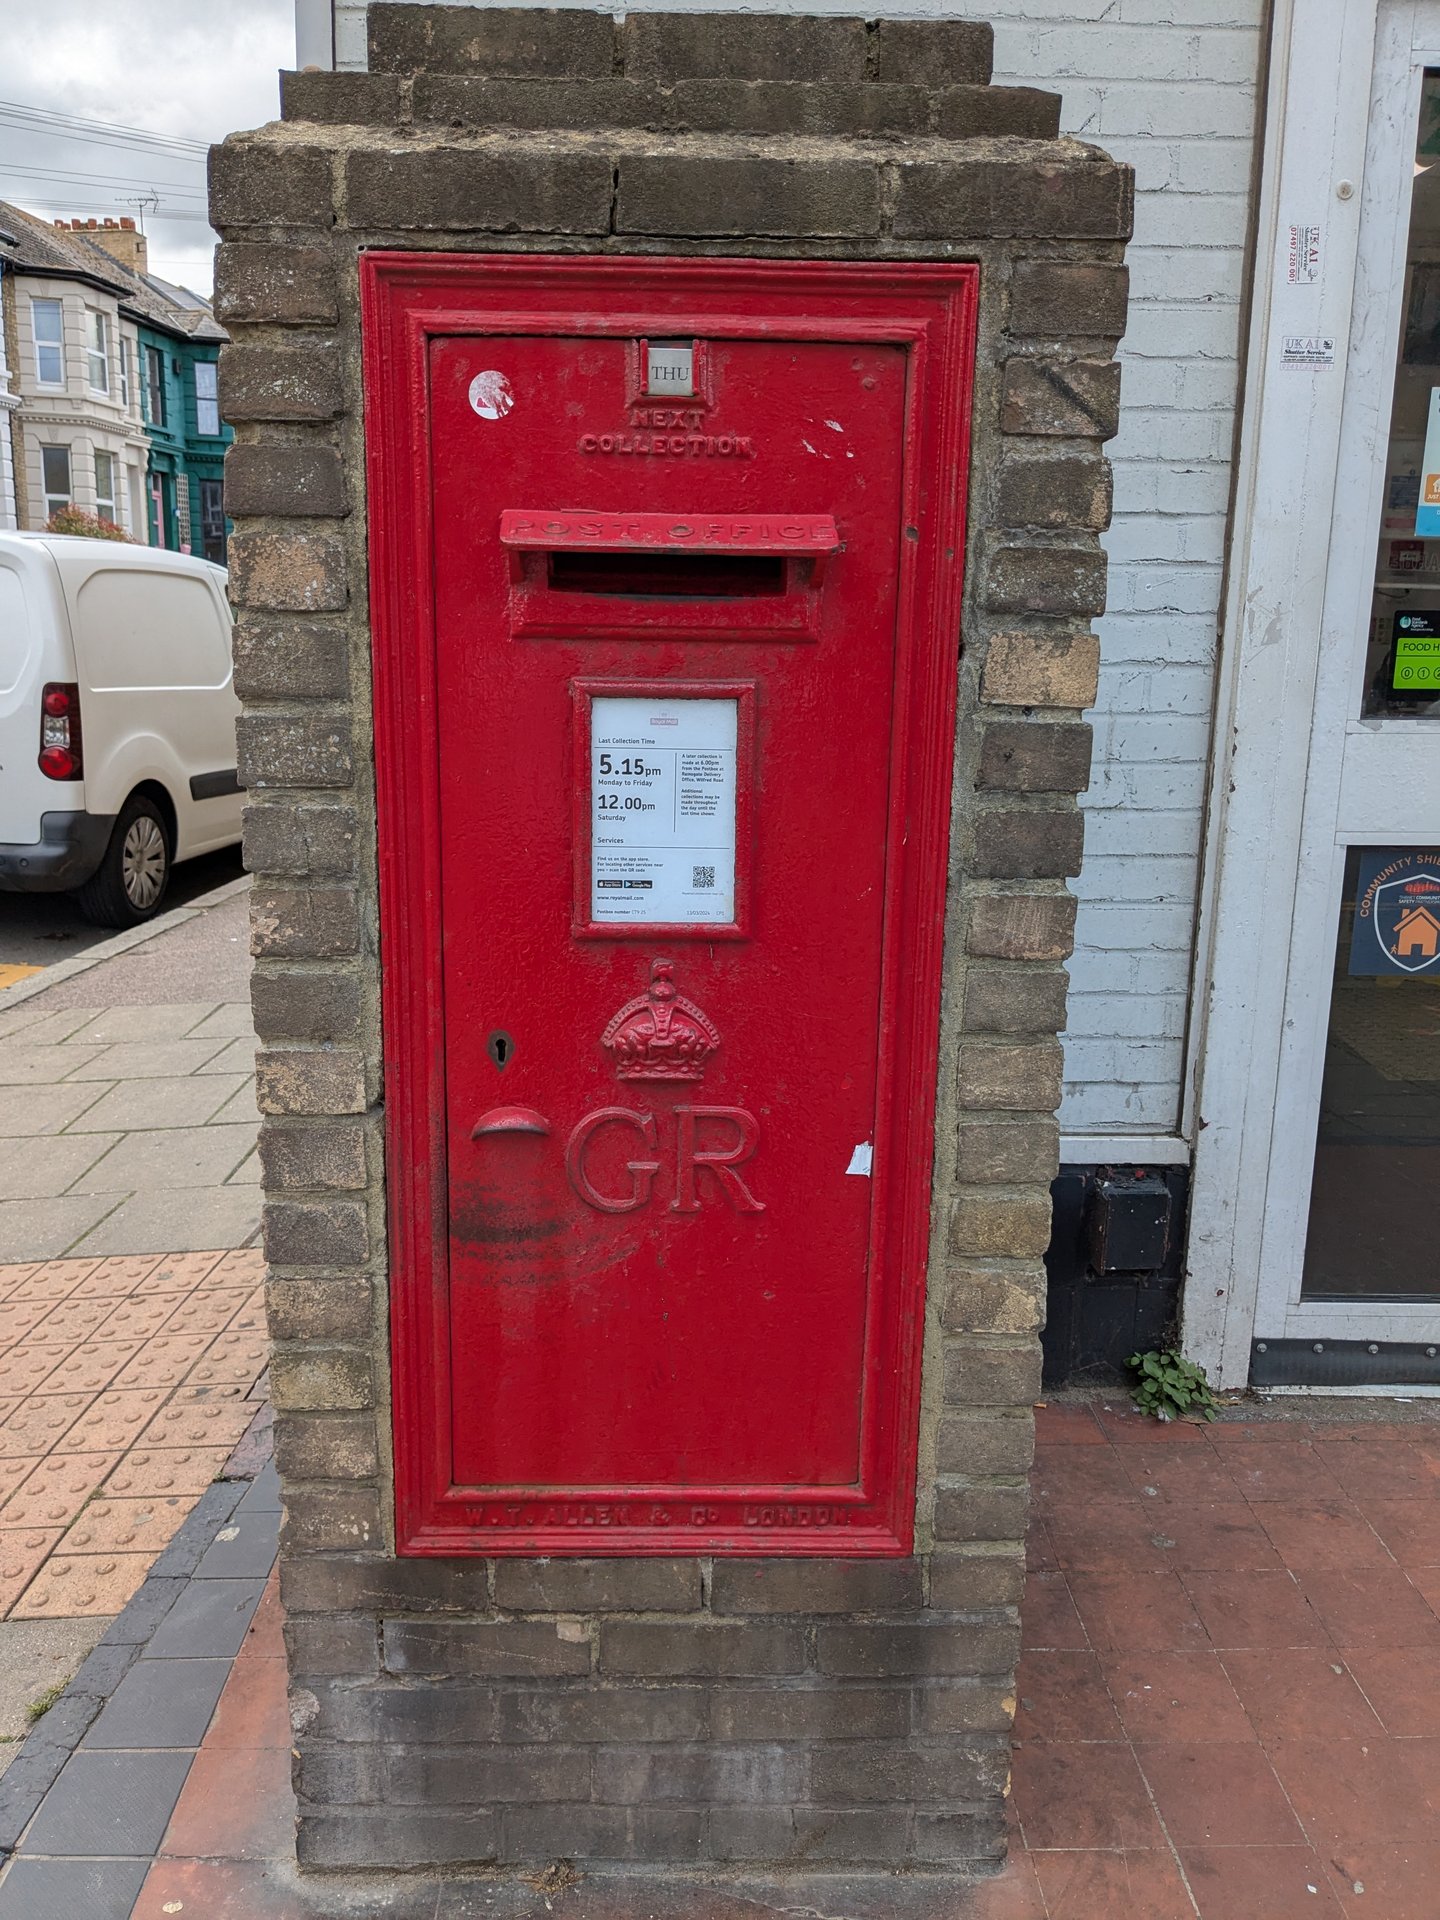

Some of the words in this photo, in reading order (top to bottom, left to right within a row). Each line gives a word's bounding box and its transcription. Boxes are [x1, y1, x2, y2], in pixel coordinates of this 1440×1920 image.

[1310, 226, 1319, 245] UK
[651, 366, 689, 381] THU
[631, 409, 706, 430] NEXT
[578, 433, 752, 457] COLLECTION
[509, 519, 640, 538] POST
[667, 522, 838, 540] OFFICE
[1403, 643, 1431, 651] FOOD
[600, 754, 661, 777] 5.15pm
[598, 779, 623, 787] Monday
[598, 794, 656, 811] 12.00pm
[597, 814, 626, 822] Saturday
[1360, 856, 1412, 918] COMMUNITY
[565, 1105, 766, 1213] GR
[545, 1506, 629, 1526] ALLEN
[651, 1505, 670, 1526] &
[744, 1505, 850, 1526] LONDON
